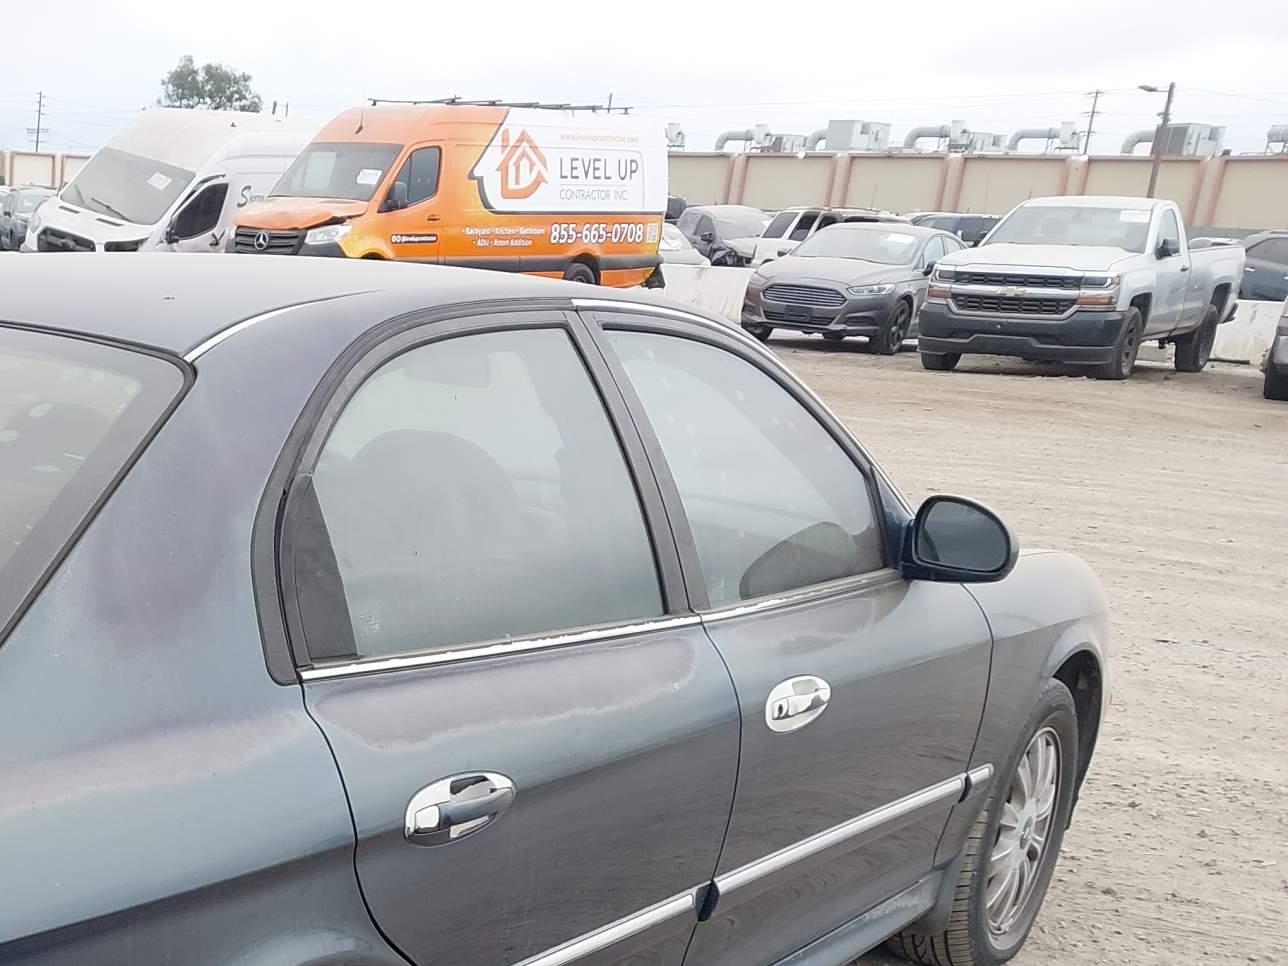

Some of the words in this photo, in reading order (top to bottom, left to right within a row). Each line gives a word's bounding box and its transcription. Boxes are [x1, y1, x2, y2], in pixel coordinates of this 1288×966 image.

[559, 157, 612, 180] LEVEL
[617, 158, 639, 181] UP
[559, 188, 611, 201] CONTRACTOR
[550, 222, 644, 244] 855-665-0708
